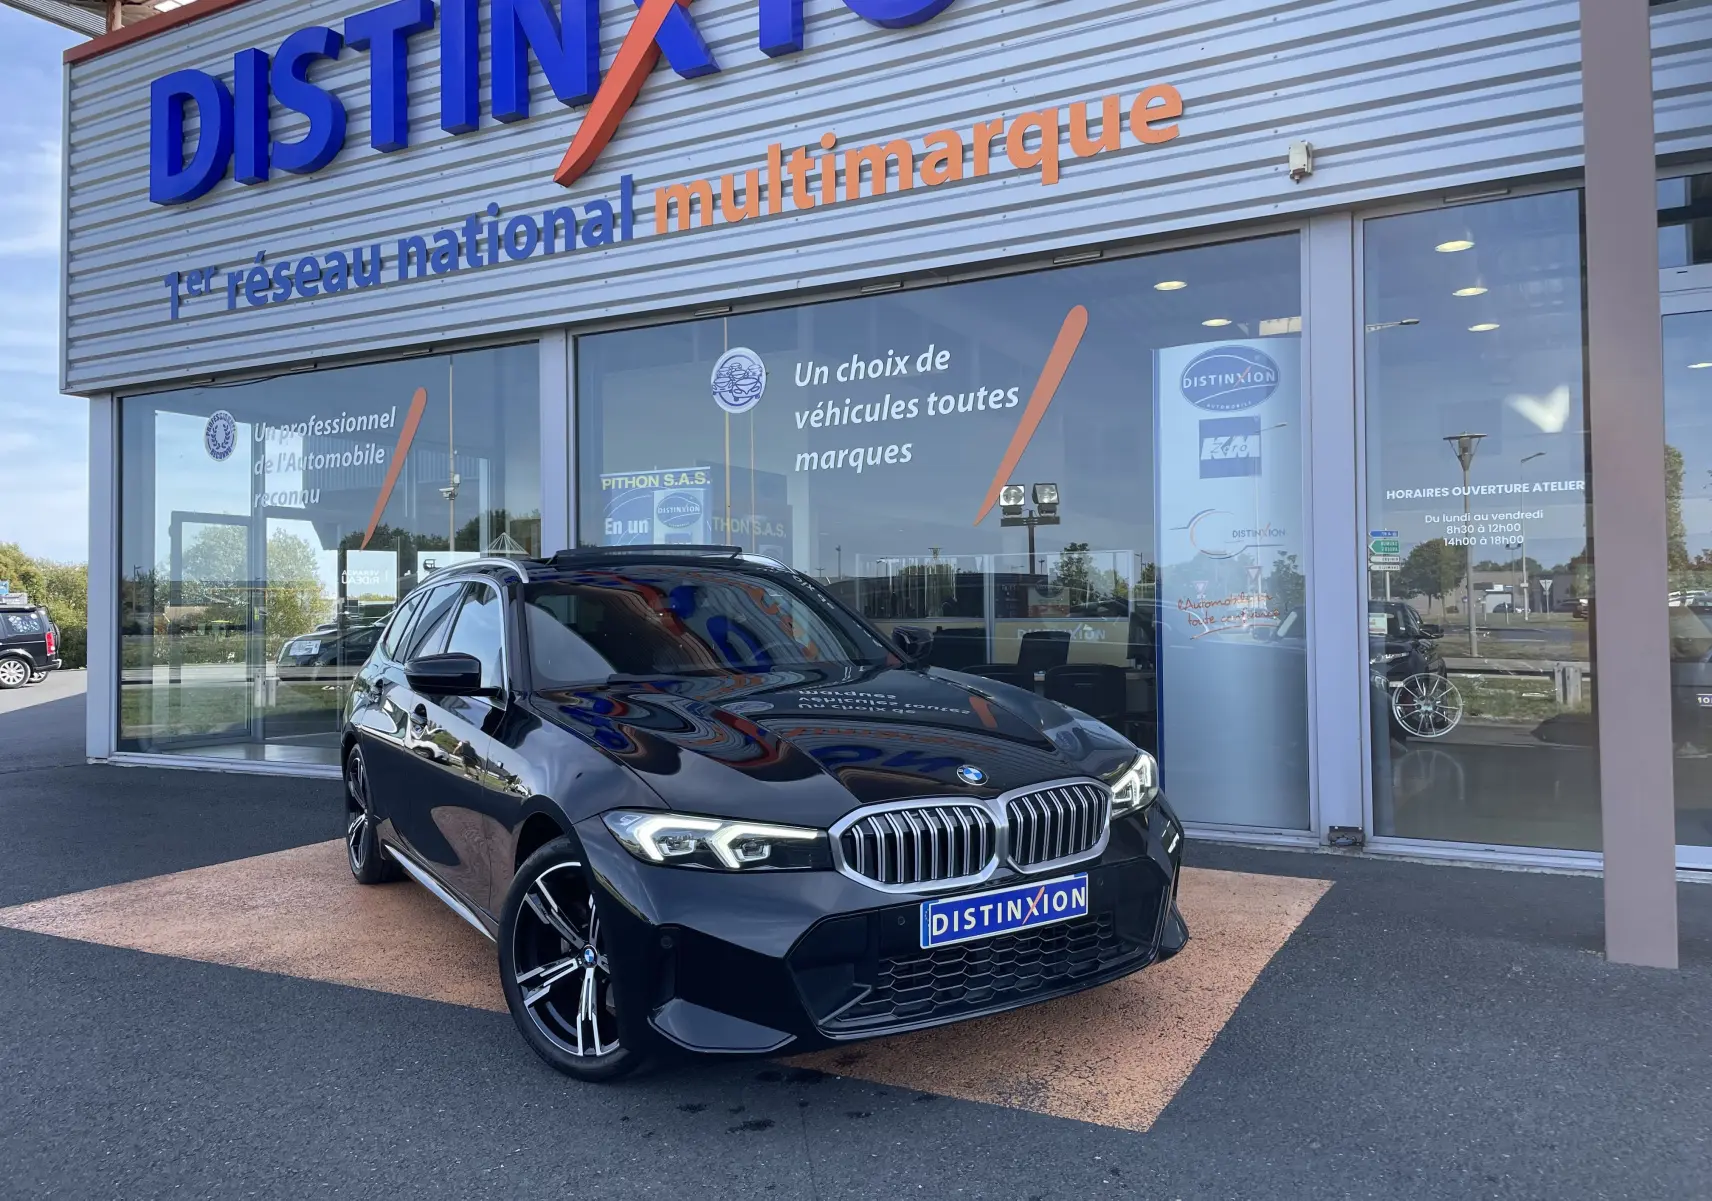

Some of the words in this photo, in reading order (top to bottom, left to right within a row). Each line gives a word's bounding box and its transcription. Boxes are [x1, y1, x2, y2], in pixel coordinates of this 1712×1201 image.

[149, 0, 956, 205] DISTINX
[164, 265, 218, 320] 1er
[226, 248, 382, 310] réseau
[398, 174, 634, 281] national
[654, 83, 1183, 235] multimarque
[795, 361, 829, 387] Un
[836, 349, 910, 382] choix
[916, 343, 950, 373] de
[1183, 366, 1275, 388] DISTINXION
[795, 393, 920, 430] véhicules
[927, 386, 1020, 416] toutes
[254, 422, 276, 443] Un
[279, 405, 397, 445] professionnel
[254, 453, 275, 476] de
[277, 442, 386, 473] l'Automobile
[794, 442, 913, 474] marques
[602, 475, 660, 491] PITHON
[663, 471, 711, 487] S.A.S.
[1386, 487, 1450, 500] HORAIRES
[1452, 483, 1530, 496] OUVERTURE
[1532, 480, 1585, 493] ATELIER
[254, 488, 321, 508] reconnu
[604, 517, 623, 535] En
[628, 519, 650, 534] un
[1425, 514, 1440, 523] Du
[1443, 512, 1471, 522] lundi
[1474, 513, 1489, 521] au
[1491, 510, 1544, 520] vendredi
[1233, 523, 1286, 539] DISTINXION
[1446, 525, 1474, 534] 8h30
[1478, 523, 1485, 533] à
[1488, 523, 1521, 532] 12h00
[1444, 537, 1477, 546] 14h00
[1479, 536, 1487, 545] à
[1490, 535, 1524, 545] 18h00
[931, 886, 1086, 936] DISTINXION
